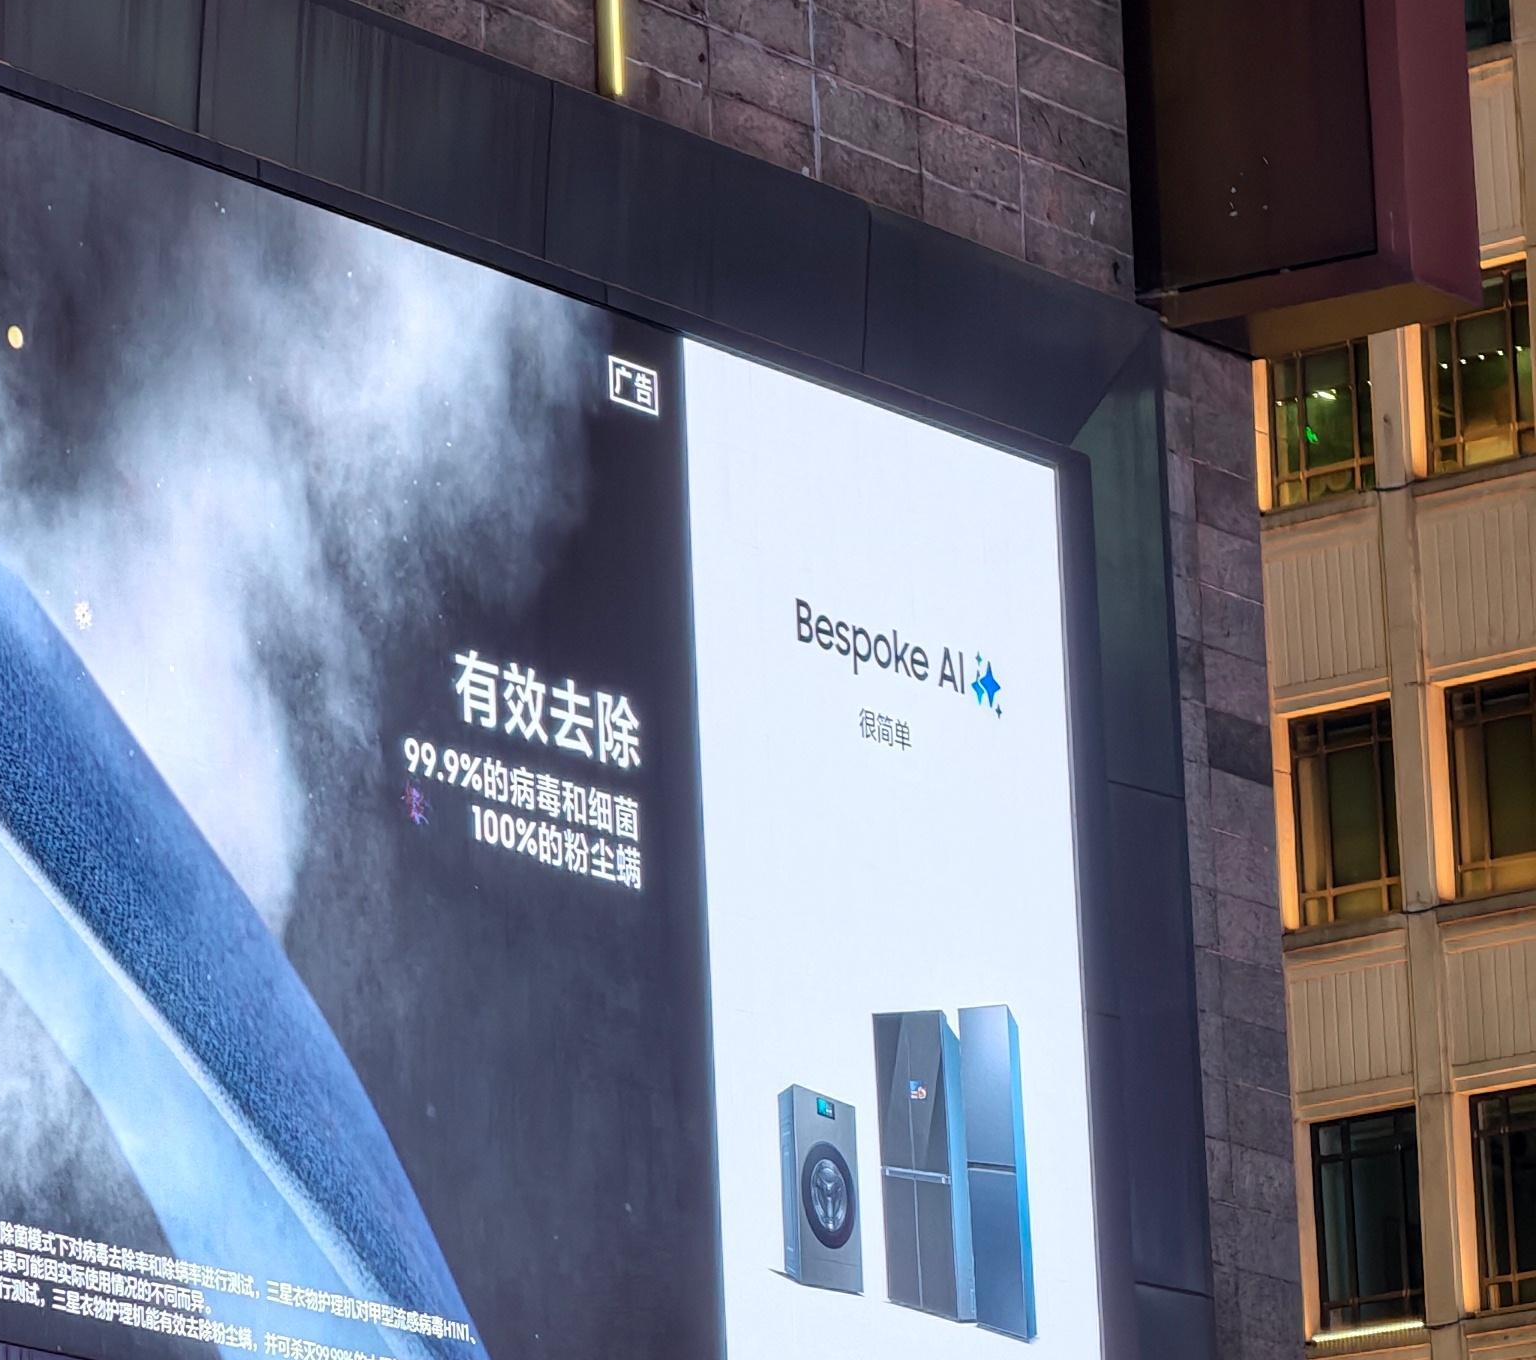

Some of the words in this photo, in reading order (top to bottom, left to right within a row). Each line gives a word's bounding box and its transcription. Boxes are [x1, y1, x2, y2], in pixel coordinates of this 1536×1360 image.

[614, 365, 653, 406] 广告
[795, 597, 930, 680] Bespoke
[938, 646, 965, 694] AI
[453, 649, 641, 770] 有效去除
[858, 707, 912, 751] 很简单
[404, 737, 639, 842] 99.9%的病毒和细菌
[471, 804, 642, 891] 100%的粉尘螨
